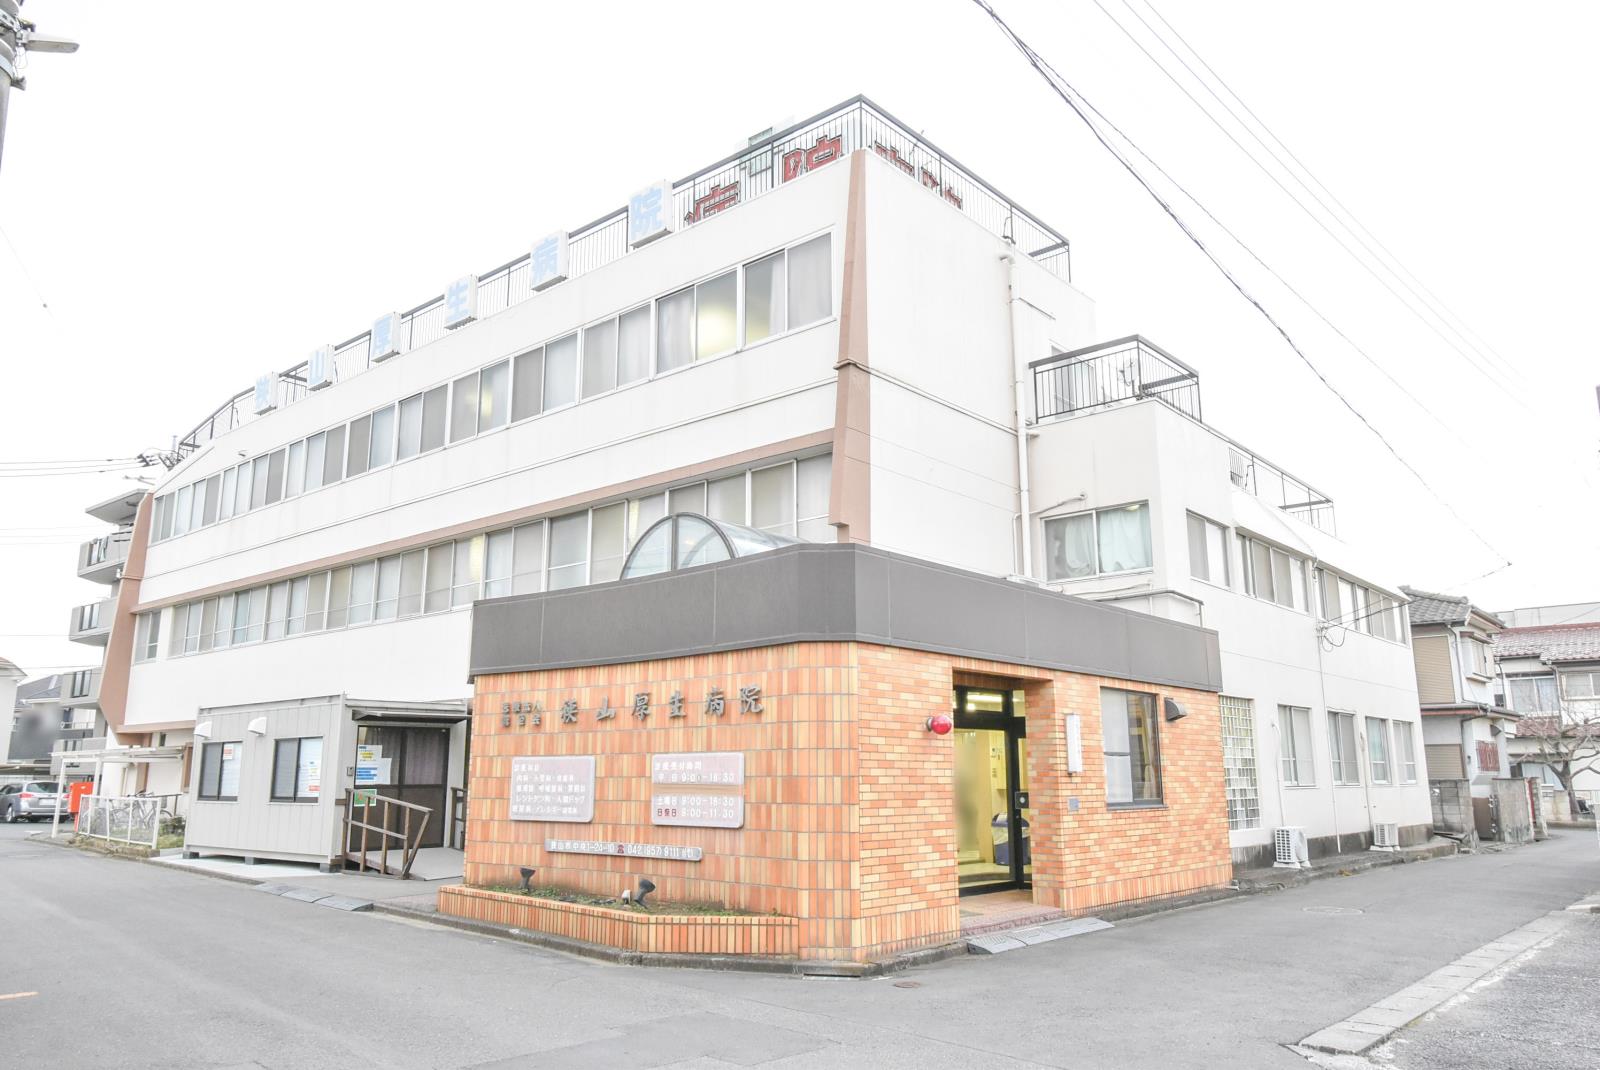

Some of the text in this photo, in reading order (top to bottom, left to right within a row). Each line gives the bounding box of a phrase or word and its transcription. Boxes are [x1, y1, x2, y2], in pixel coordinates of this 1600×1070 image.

[561, 684, 764, 723] 狭山厚生病院
